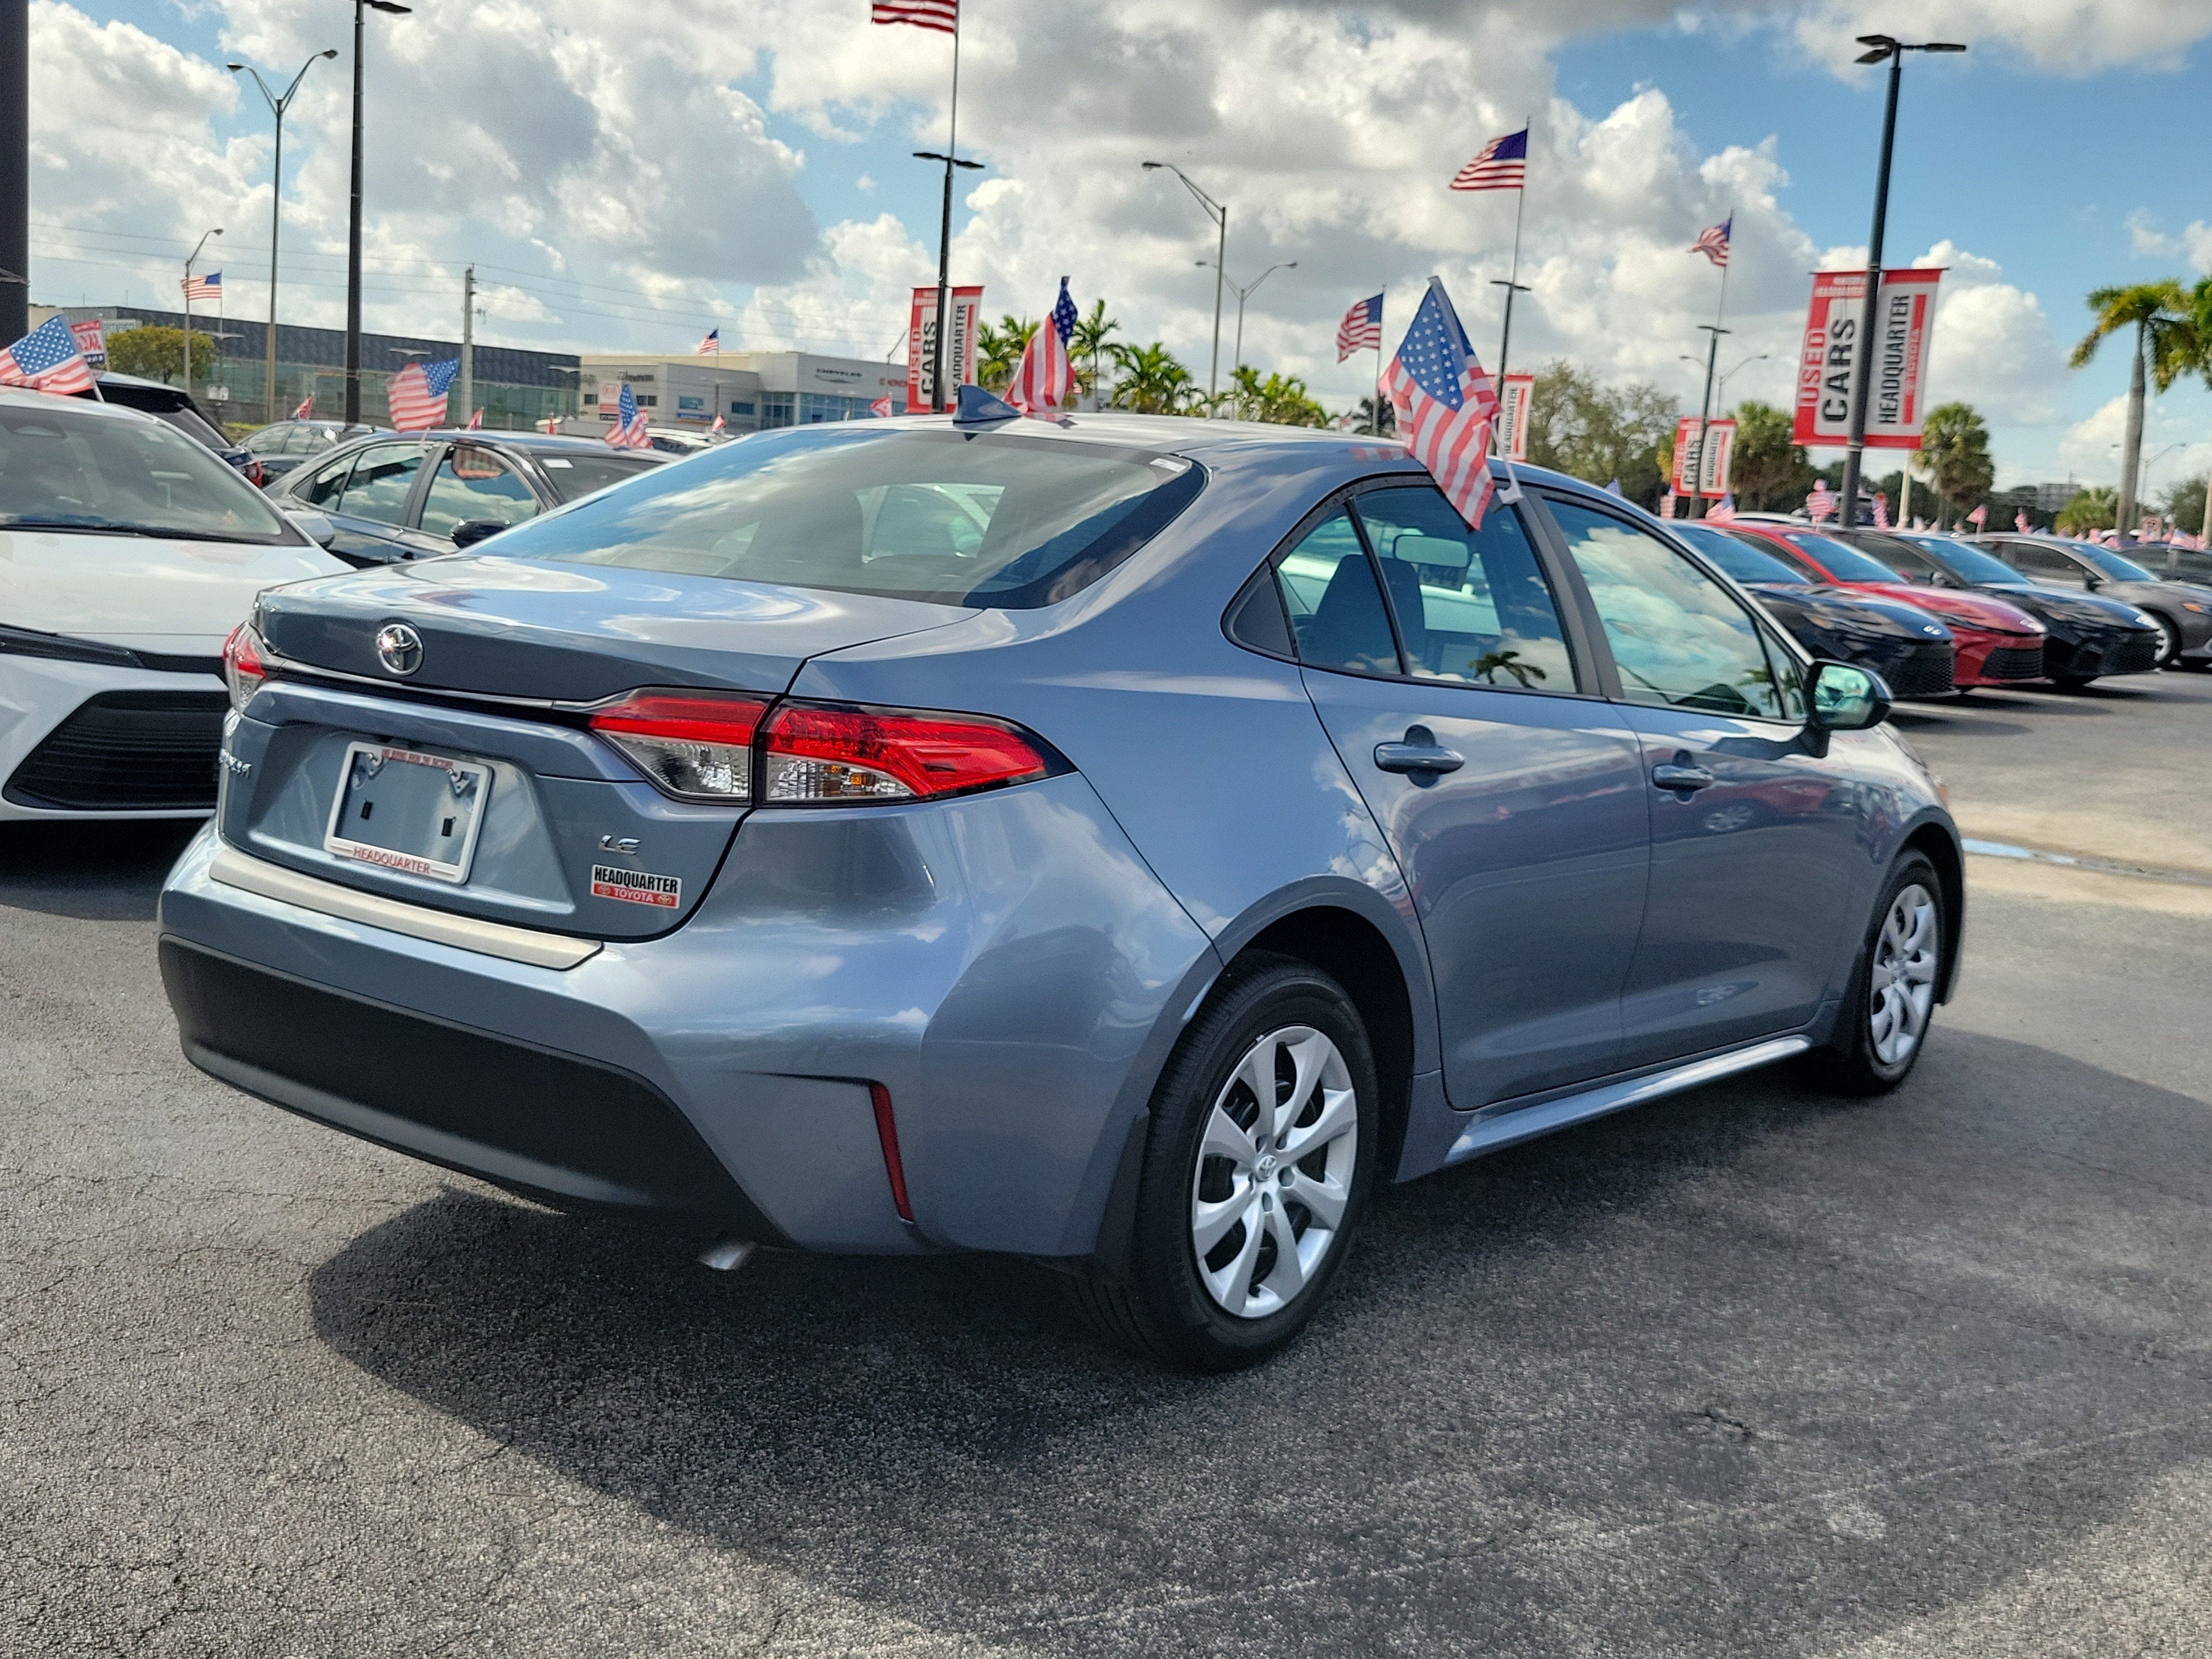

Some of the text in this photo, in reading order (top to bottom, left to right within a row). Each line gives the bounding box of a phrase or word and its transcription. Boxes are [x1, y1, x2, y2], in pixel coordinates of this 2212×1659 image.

[911, 330, 921, 381] USED
[922, 321, 937, 394] CARS
[1799, 332, 1825, 402] USED
[1823, 319, 1855, 421] CARS
[1878, 295, 1910, 424] HEADQUARTER
[1684, 440, 1701, 484] CARS
[353, 847, 431, 874] HEADQUARTER
[599, 834, 641, 855] LE
[594, 866, 678, 894] HEADQUARTER
[613, 887, 654, 902] TOYOTA
